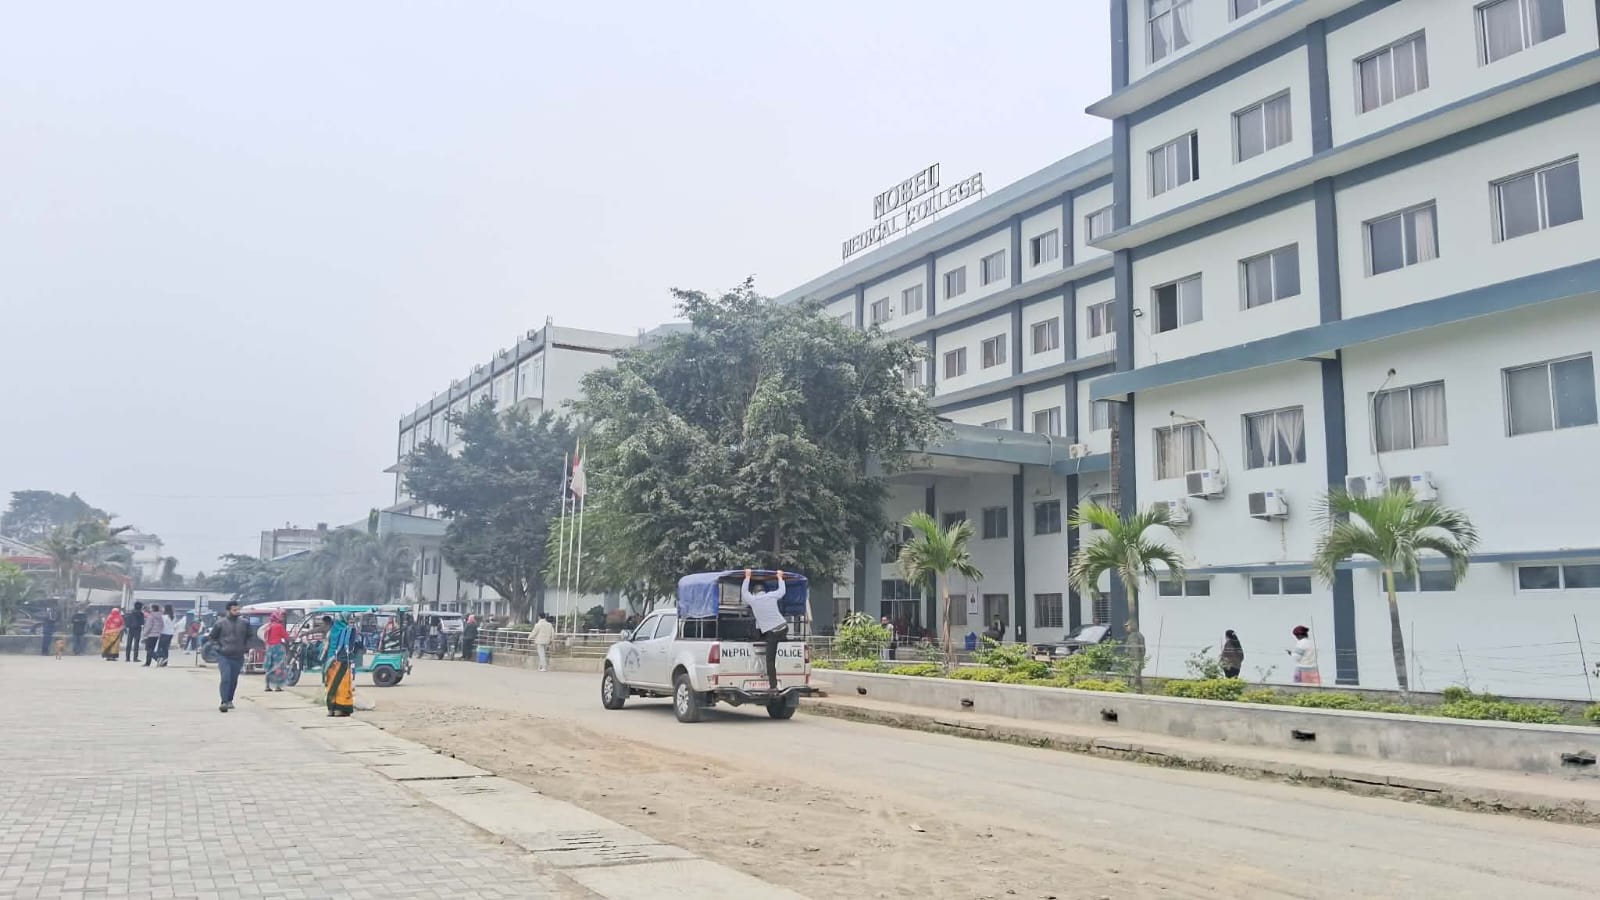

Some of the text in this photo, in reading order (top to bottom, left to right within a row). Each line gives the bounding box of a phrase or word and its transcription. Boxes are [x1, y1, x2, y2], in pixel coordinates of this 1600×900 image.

[842, 172, 982, 259] MEDICAL COLLEGE
[873, 163, 940, 220] NOBEL
[721, 647, 802, 658] NEPAL OLICE
